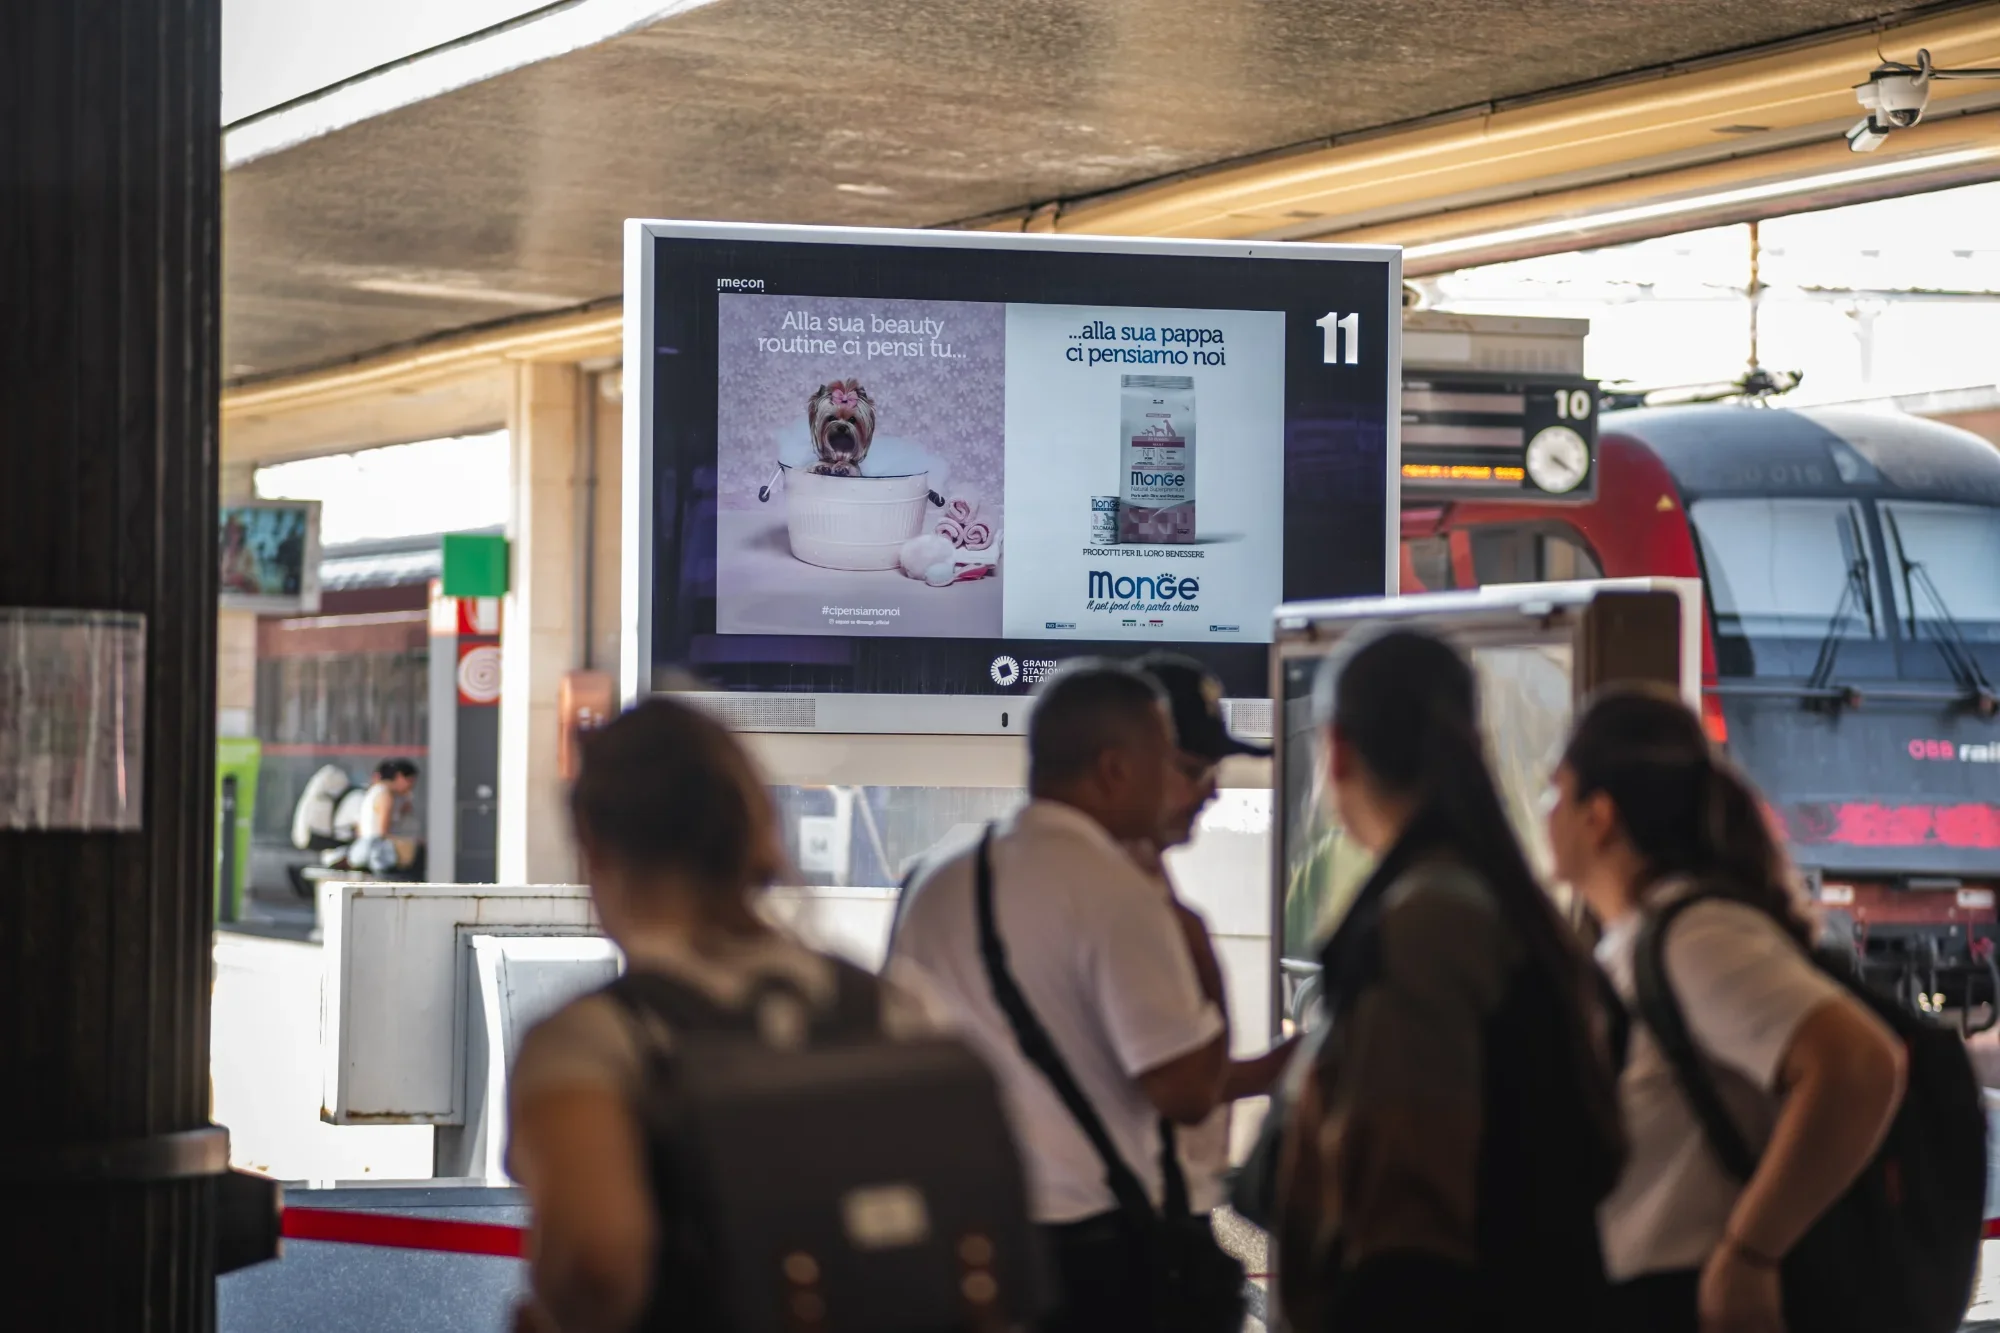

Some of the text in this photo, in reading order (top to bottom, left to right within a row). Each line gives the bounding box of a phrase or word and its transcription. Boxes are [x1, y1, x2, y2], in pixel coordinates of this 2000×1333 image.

[717, 278, 765, 293] imecon
[781, 311, 945, 340] Alla sua beauty
[1068, 320, 1225, 347] ...alla sua pappa
[757, 336, 967, 360] routine ci pensi tu...
[1315, 311, 1359, 365] 11
[1065, 343, 1226, 367] ci pensiamo noi
[1555, 388, 1591, 421] 10
[1082, 549, 1120, 557] PRODOTTI
[1144, 550, 1165, 558] LORO
[821, 605, 901, 618] #cipensiamonoi
[1086, 600, 1200, 613] Il pet food che parla chiaro
[1022, 659, 1057, 667] GRANDI
